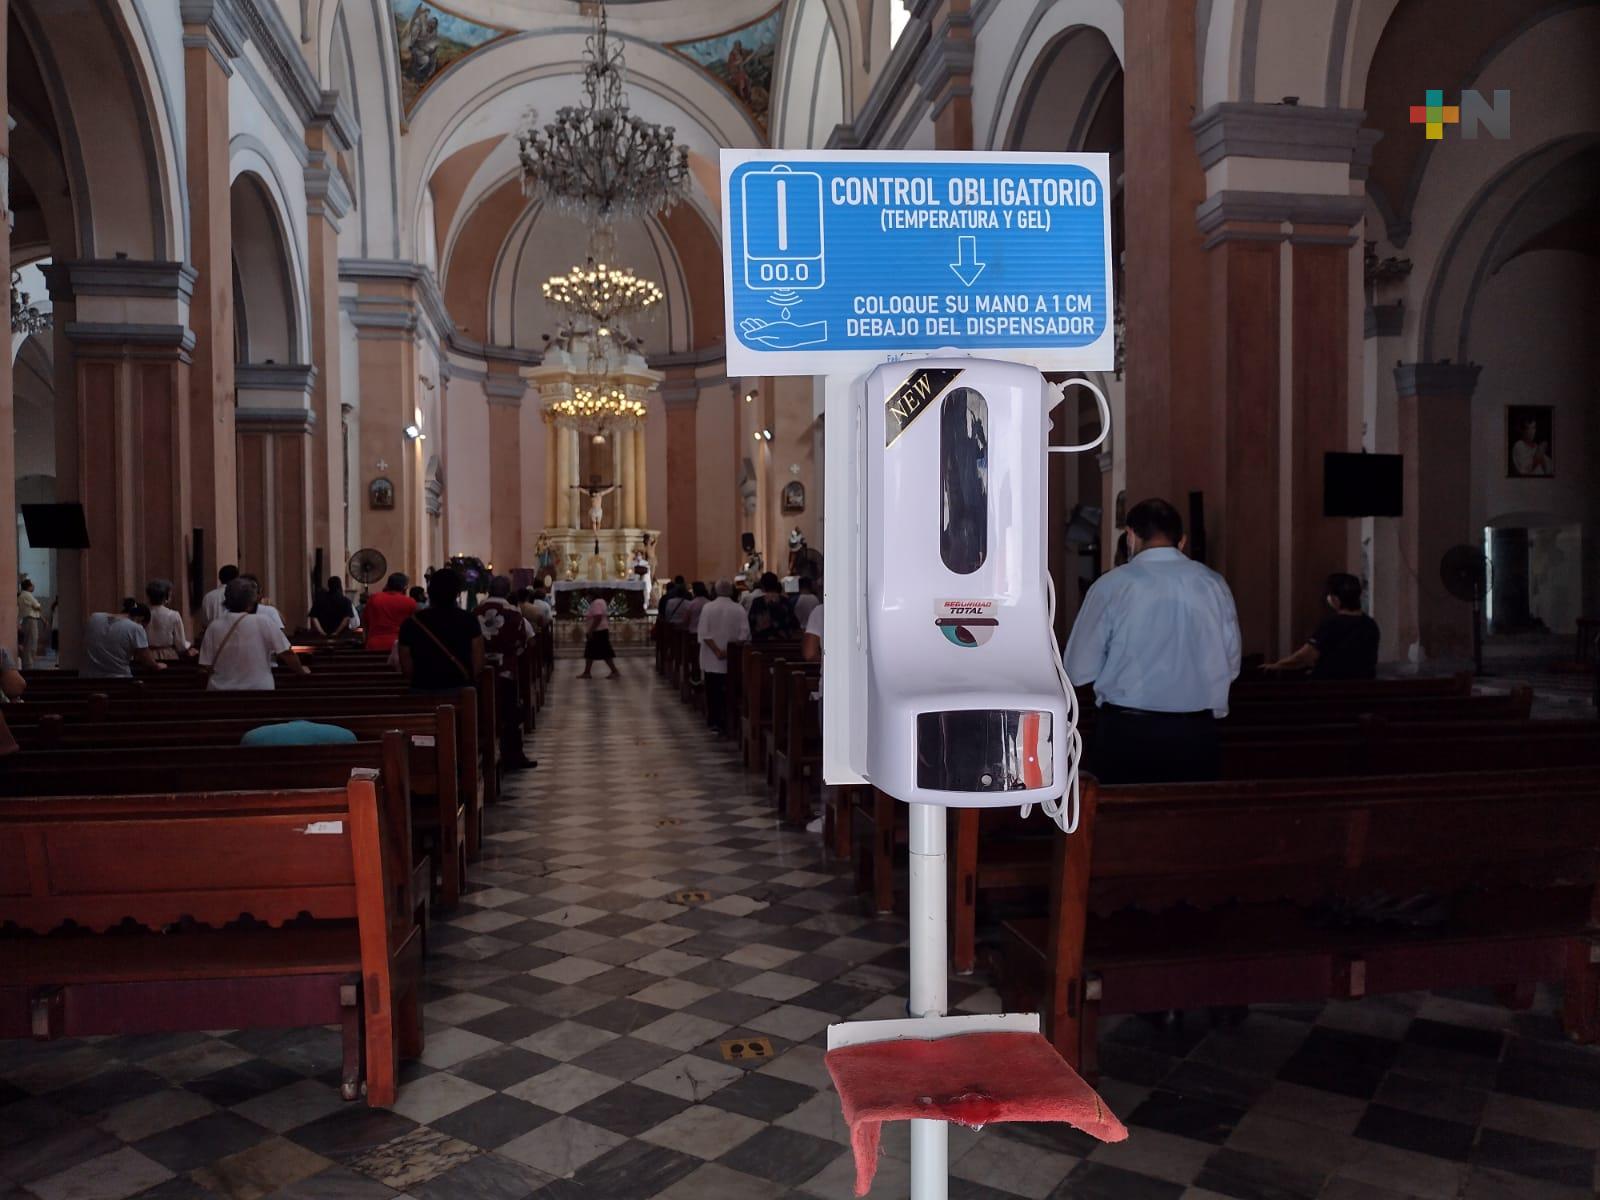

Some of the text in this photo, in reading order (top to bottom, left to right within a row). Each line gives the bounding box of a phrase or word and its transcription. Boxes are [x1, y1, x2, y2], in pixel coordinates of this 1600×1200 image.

[831, 176, 1096, 207] CONTROL OBLIGATORIO
[881, 208, 1051, 232] (TEMPERATURA Y GEL)
[760, 263, 809, 282] 00.0
[853, 295, 1092, 315] COLOQUE SU MANO A 1 CM
[847, 316, 1095, 337] DEBAJO DEL DISPENSADOR
[890, 373, 934, 425] NEW
[950, 607, 983, 615] TOTAL
